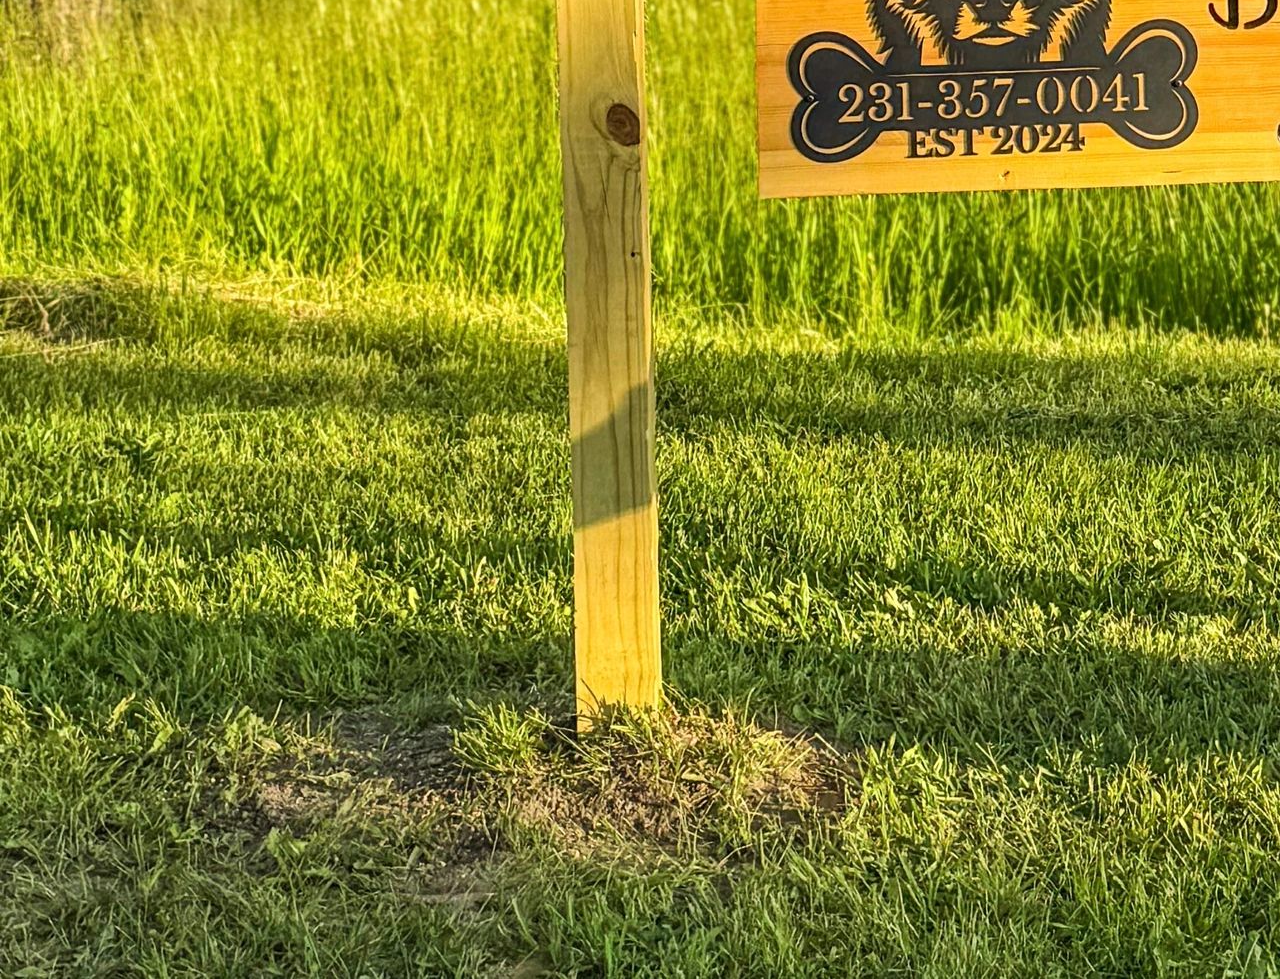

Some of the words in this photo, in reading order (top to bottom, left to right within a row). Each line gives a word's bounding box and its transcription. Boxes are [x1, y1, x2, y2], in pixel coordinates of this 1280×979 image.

[837, 72, 1151, 124] 231-357-0041
[906, 126, 984, 159] EST
[989, 123, 1086, 156] 2024
